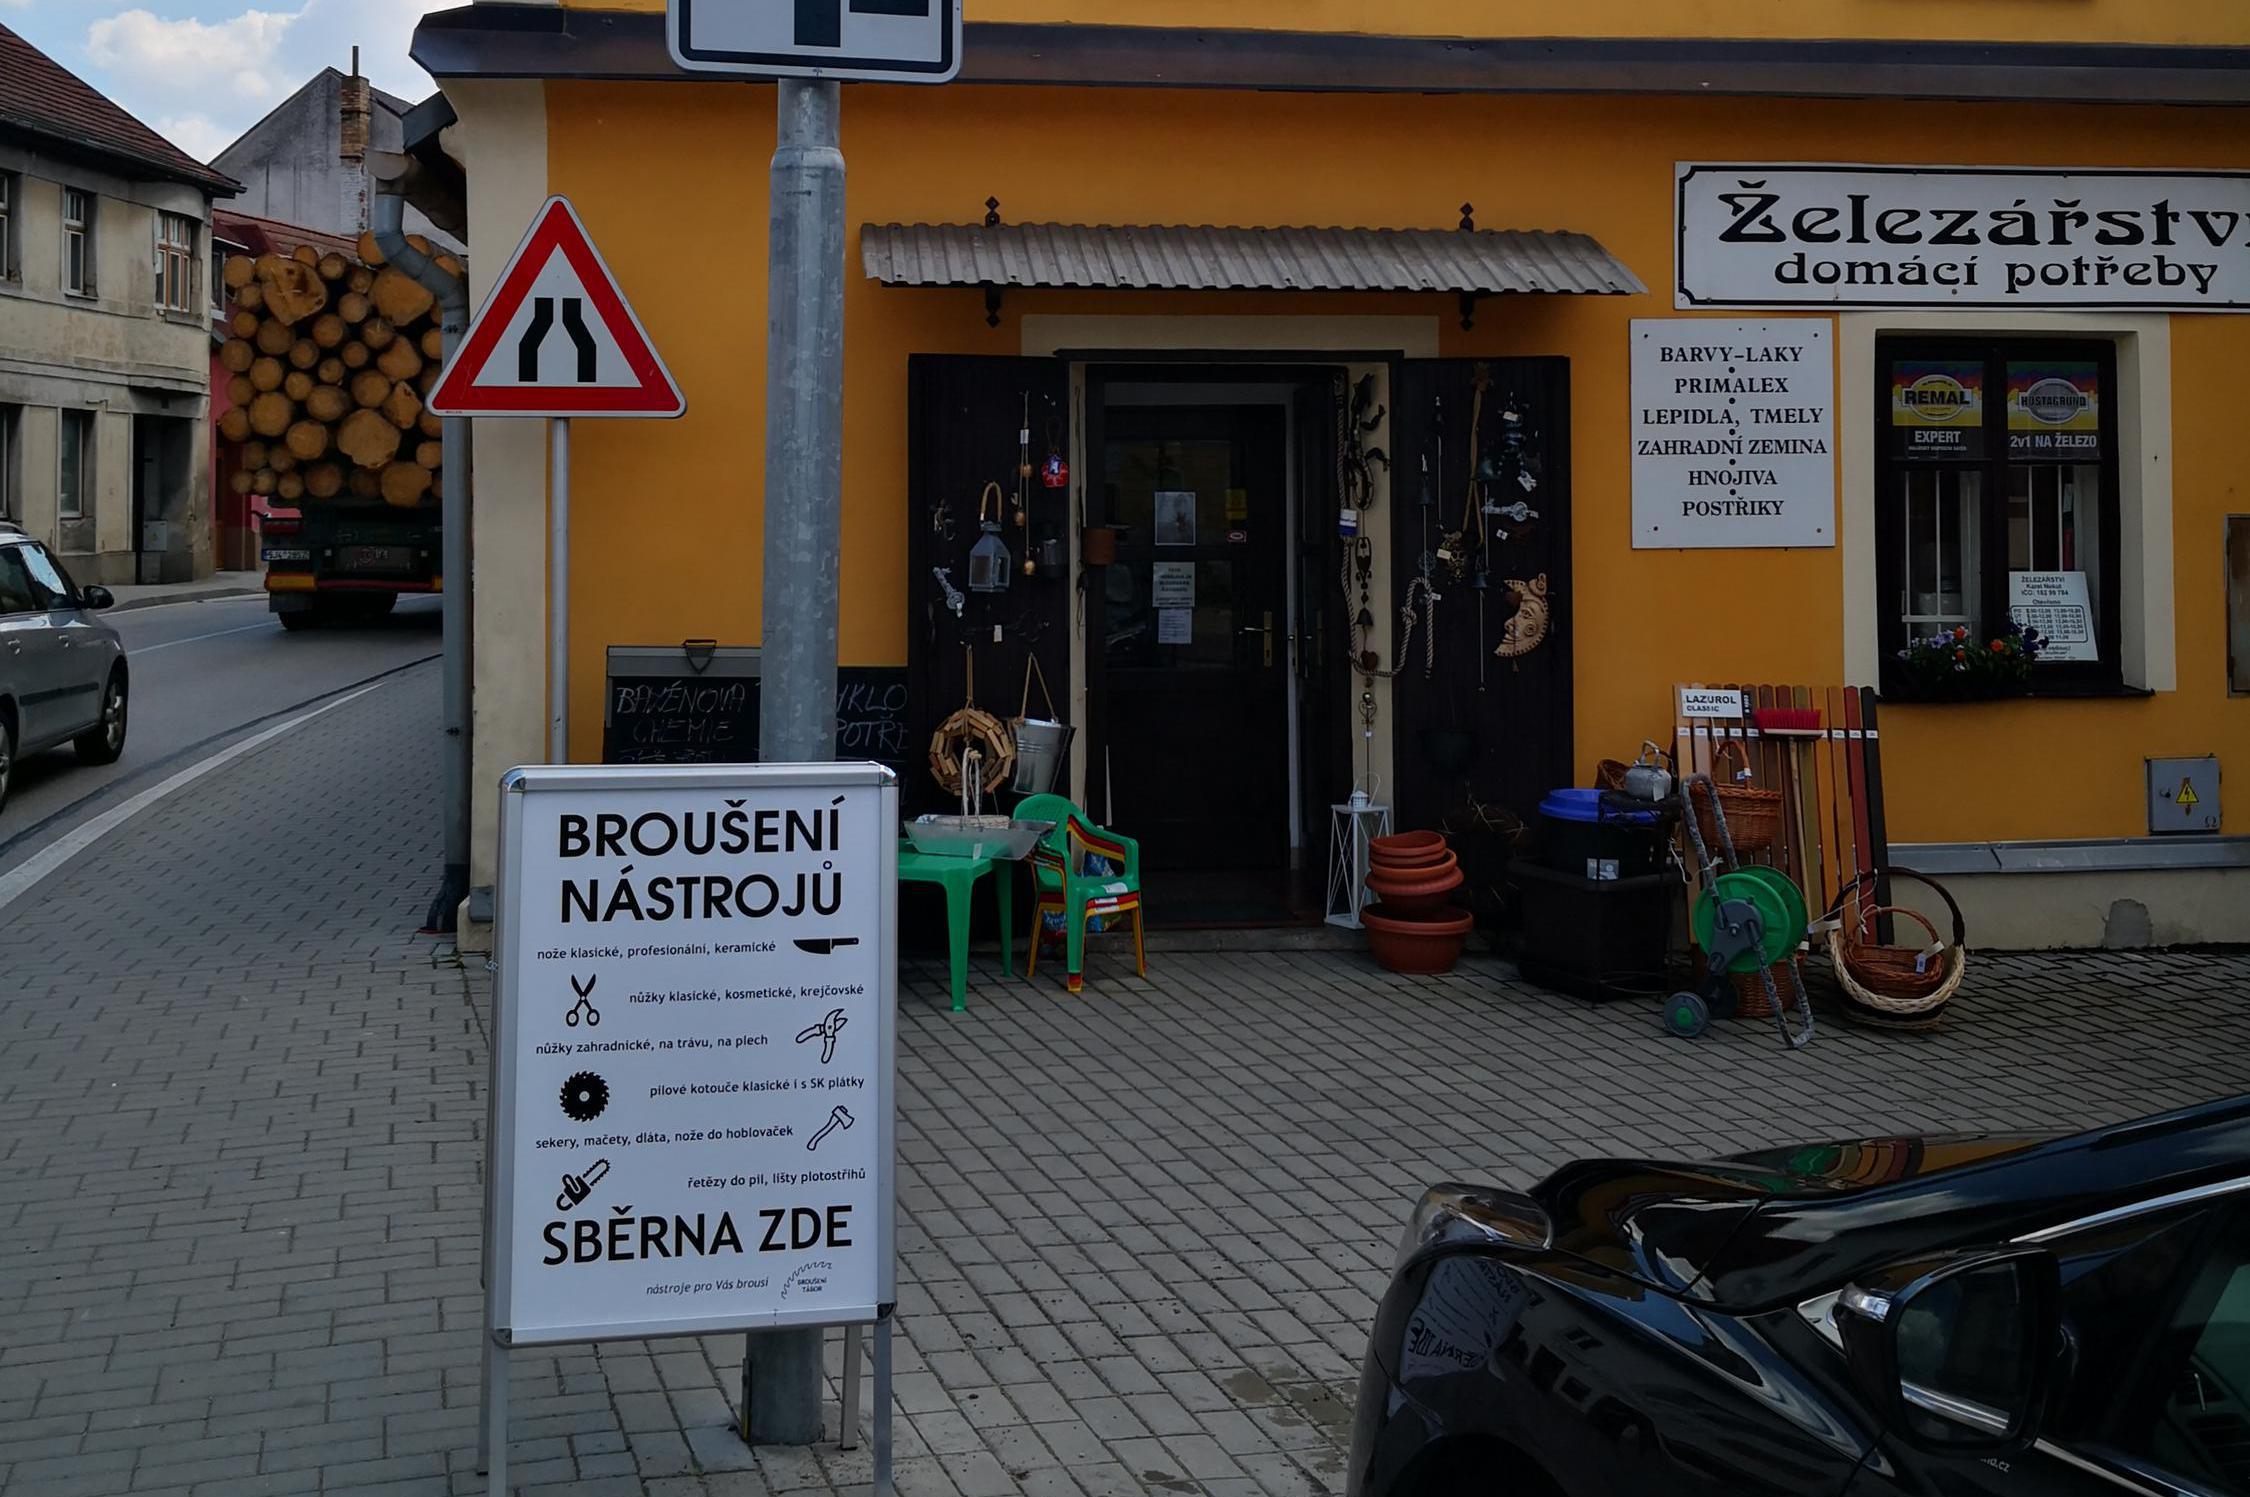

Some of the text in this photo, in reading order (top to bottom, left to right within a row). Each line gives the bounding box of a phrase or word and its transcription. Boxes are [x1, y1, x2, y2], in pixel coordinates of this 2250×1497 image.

[1718, 180, 2250, 247] Železářstv
[1775, 253, 2217, 294] domácí potřeby
[1674, 377, 1789, 394] PRIMALEX
[1904, 390, 1970, 405] REMAL
[1642, 407, 1824, 428] LEPIDLA, TMELY
[1638, 435, 1828, 456] ZAHRADNÍ ZEMINA
[1914, 431, 1961, 443] EXPERT
[2010, 431, 2097, 448] 2v1 NA ŽELEZO
[1687, 469, 1778, 486] HNOJIVA
[1682, 496, 1785, 517] POSTŘIKY
[1685, 694, 1737, 704] LAZUROL
[560, 795, 845, 857] BROUŠENÍ
[562, 861, 841, 923] NÁSTROJŮ
[537, 941, 776, 960] nože klasické, profesionální, keramické
[629, 984, 864, 1005] nůžky klasické, kosmetické, krejčovské
[536, 1034, 768, 1056] nůžky zahradnické, na trávu, na plech
[650, 1084, 687, 1099] pilové
[690, 1081, 740, 1094] kotouče
[742, 1079, 790, 1092] klasické
[800, 1080, 807, 1090] s
[810, 1077, 825, 1089] SK
[828, 1076, 865, 1090] plátky
[535, 1125, 793, 1150] sekery, mačety, dláta, nože do hoblovaček
[687, 1167, 866, 1189] řetězy do pil, lišty plotostřihů
[543, 1205, 852, 1265] SBĚRNA ZDE
[646, 1282, 692, 1296] nástroje
[693, 1282, 713, 1294] pro
[715, 1279, 734, 1290] Vás
